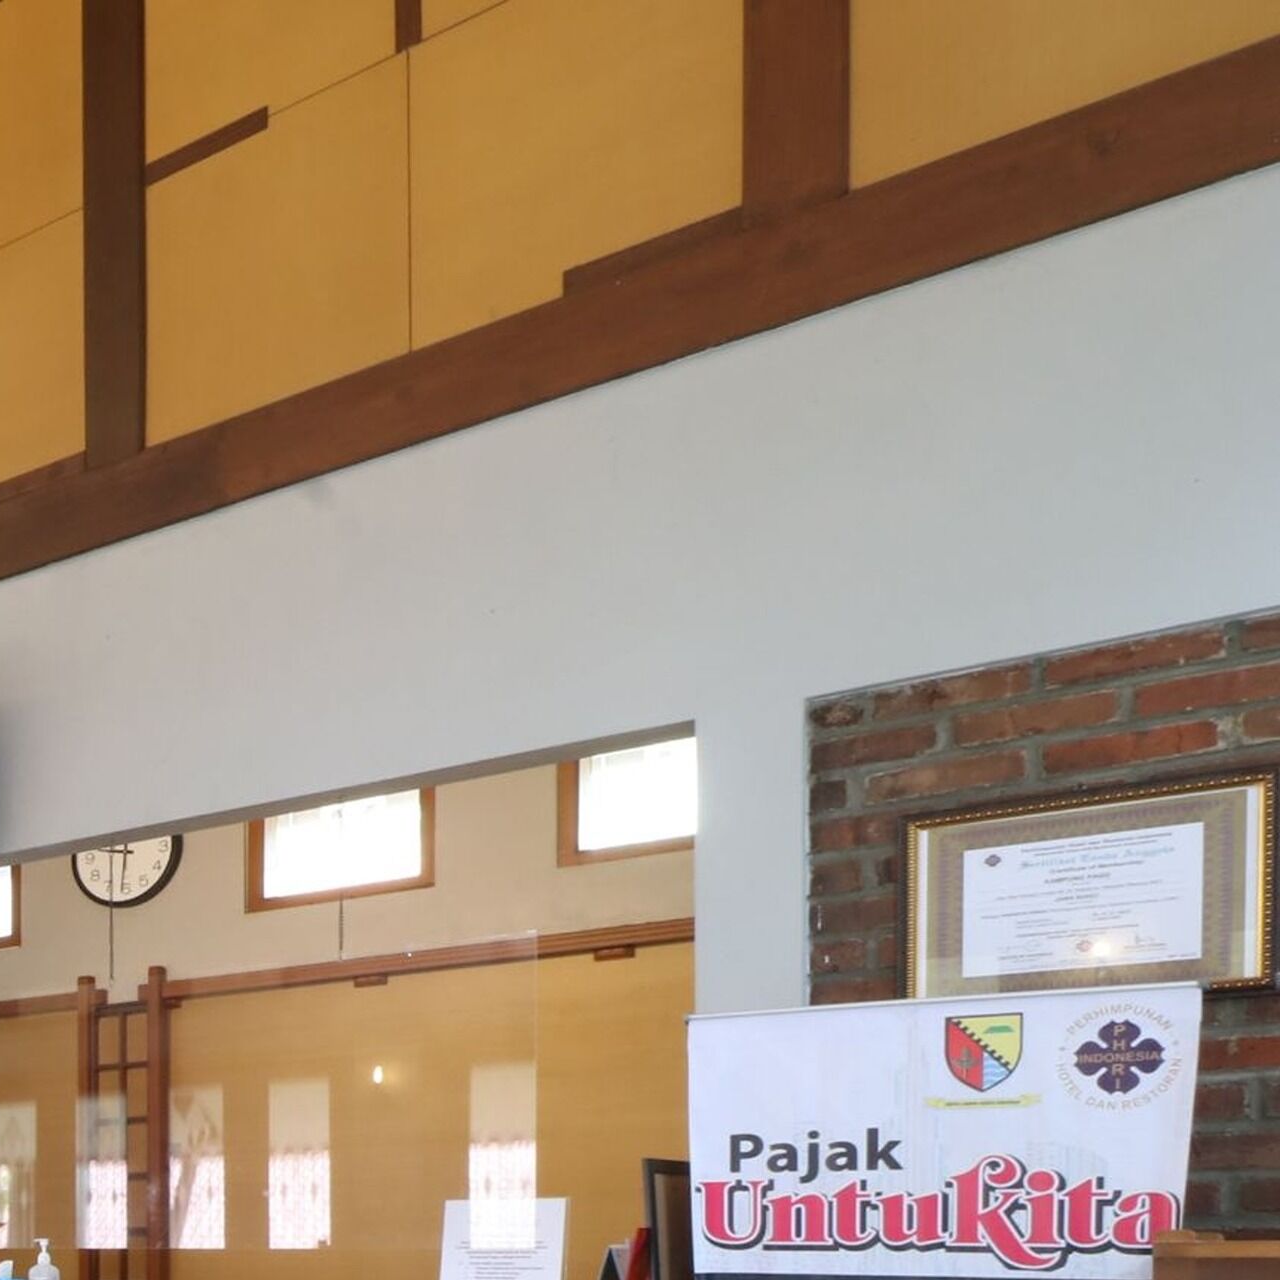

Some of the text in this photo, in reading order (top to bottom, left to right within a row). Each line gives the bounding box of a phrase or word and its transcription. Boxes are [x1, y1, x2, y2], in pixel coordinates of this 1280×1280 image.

[1066, 1003, 1174, 1036] PERHIMPUNAN
[1078, 1050, 1161, 1064] INDONESIA
[1055, 1061, 1084, 1101] HOTEL
[1121, 1057, 1183, 1111] RESTORAN
[728, 1127, 903, 1184] Pajak
